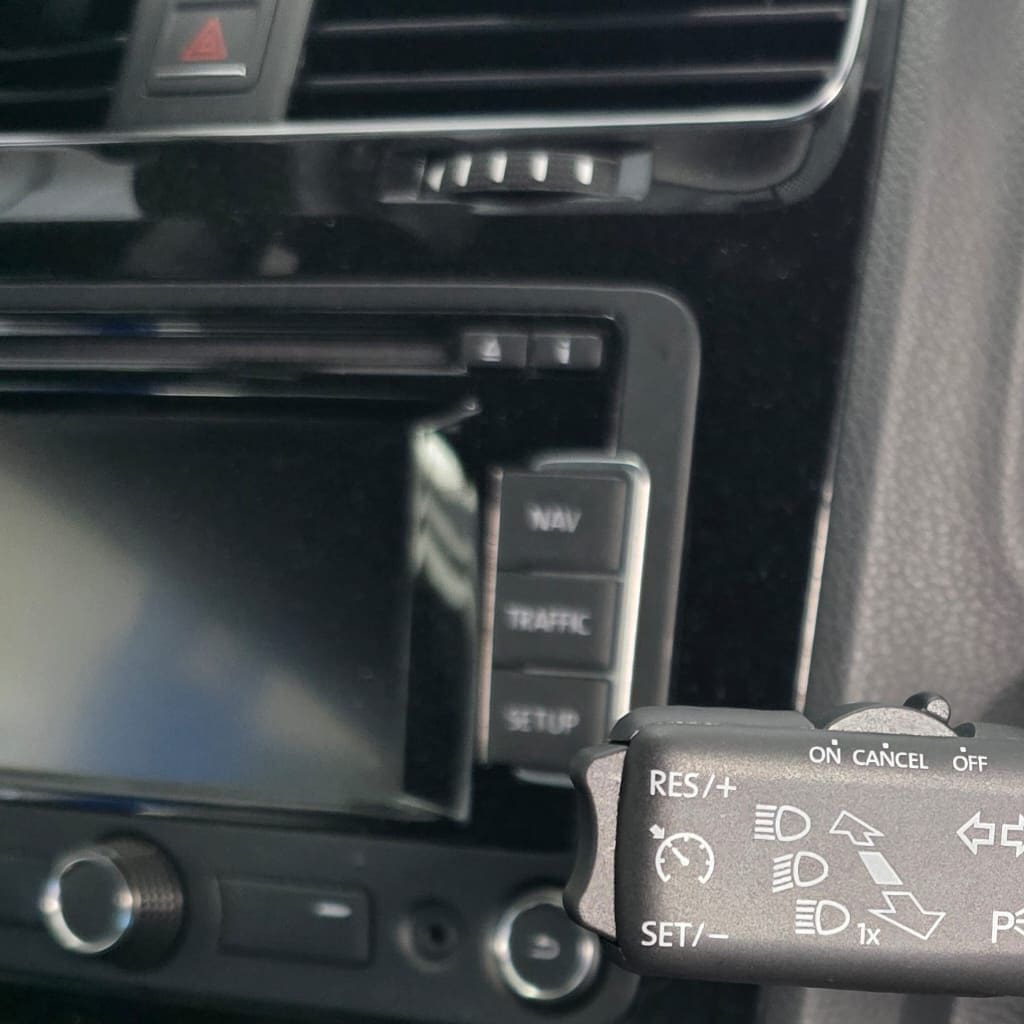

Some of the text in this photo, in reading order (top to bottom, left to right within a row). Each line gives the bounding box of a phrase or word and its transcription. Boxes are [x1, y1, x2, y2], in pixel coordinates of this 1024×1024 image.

[527, 505, 582, 533] NAV
[504, 607, 592, 635] TRAFFIC
[503, 706, 581, 735] SETUP
[809, 746, 929, 770] ON CANCEL
[953, 755, 988, 772] OFF
[650, 769, 737, 798] RES/+
[857, 923, 881, 945] 1x
